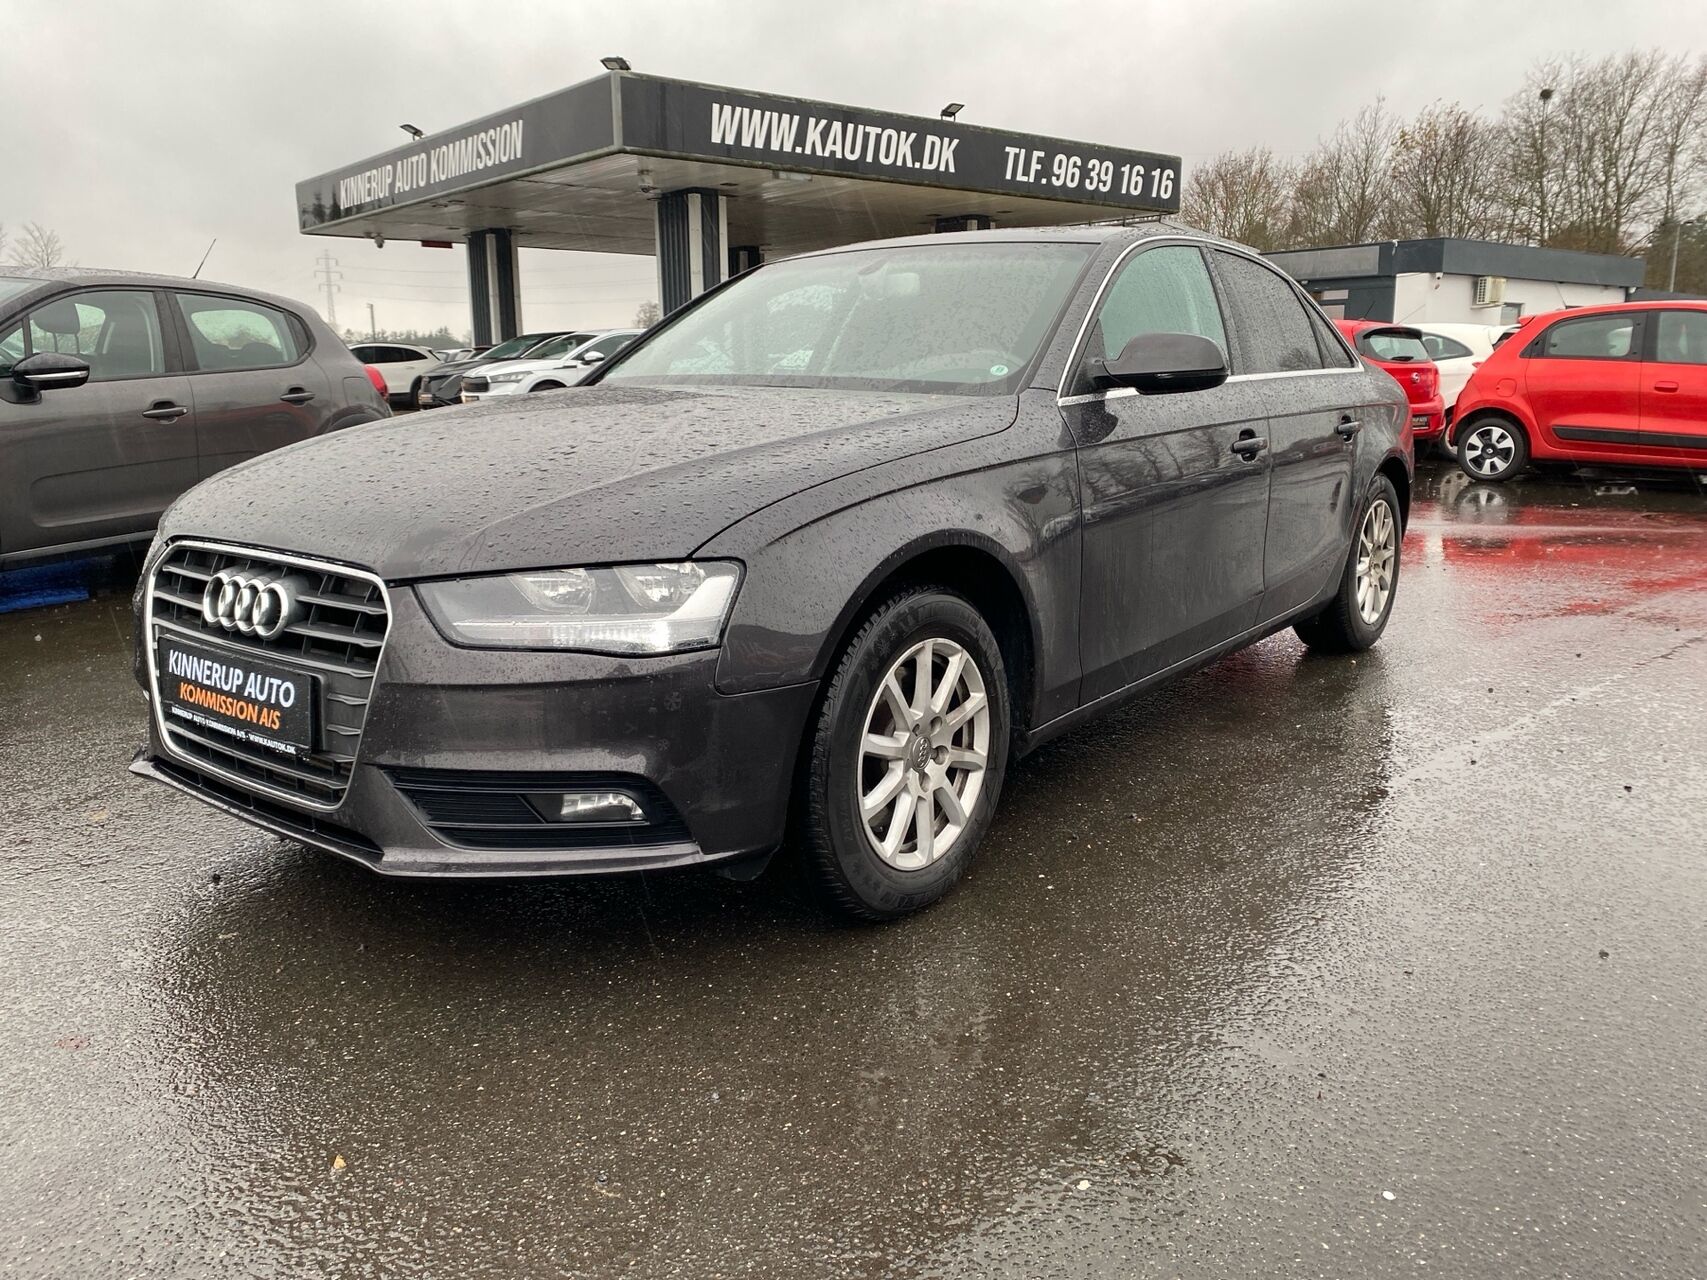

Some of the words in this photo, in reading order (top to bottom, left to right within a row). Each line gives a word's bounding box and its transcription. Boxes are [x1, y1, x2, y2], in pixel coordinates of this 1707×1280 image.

[339, 165, 393, 210] KINNERUP
[394, 152, 427, 194] AUTO
[429, 119, 524, 184] KOMMISSION
[711, 103, 960, 174] WWW.KAUTOK.DK
[1004, 146, 1047, 185] TLF.
[1051, 153, 1082, 189] 96
[1084, 158, 1114, 193] 39
[1120, 163, 1145, 197] 16
[1151, 168, 1175, 201] 16
[168, 649, 244, 693] KINNERUP
[244, 672, 296, 708] AUTO
[179, 682, 259, 723] KOMMISSION
[259, 704, 281, 730] A/S
